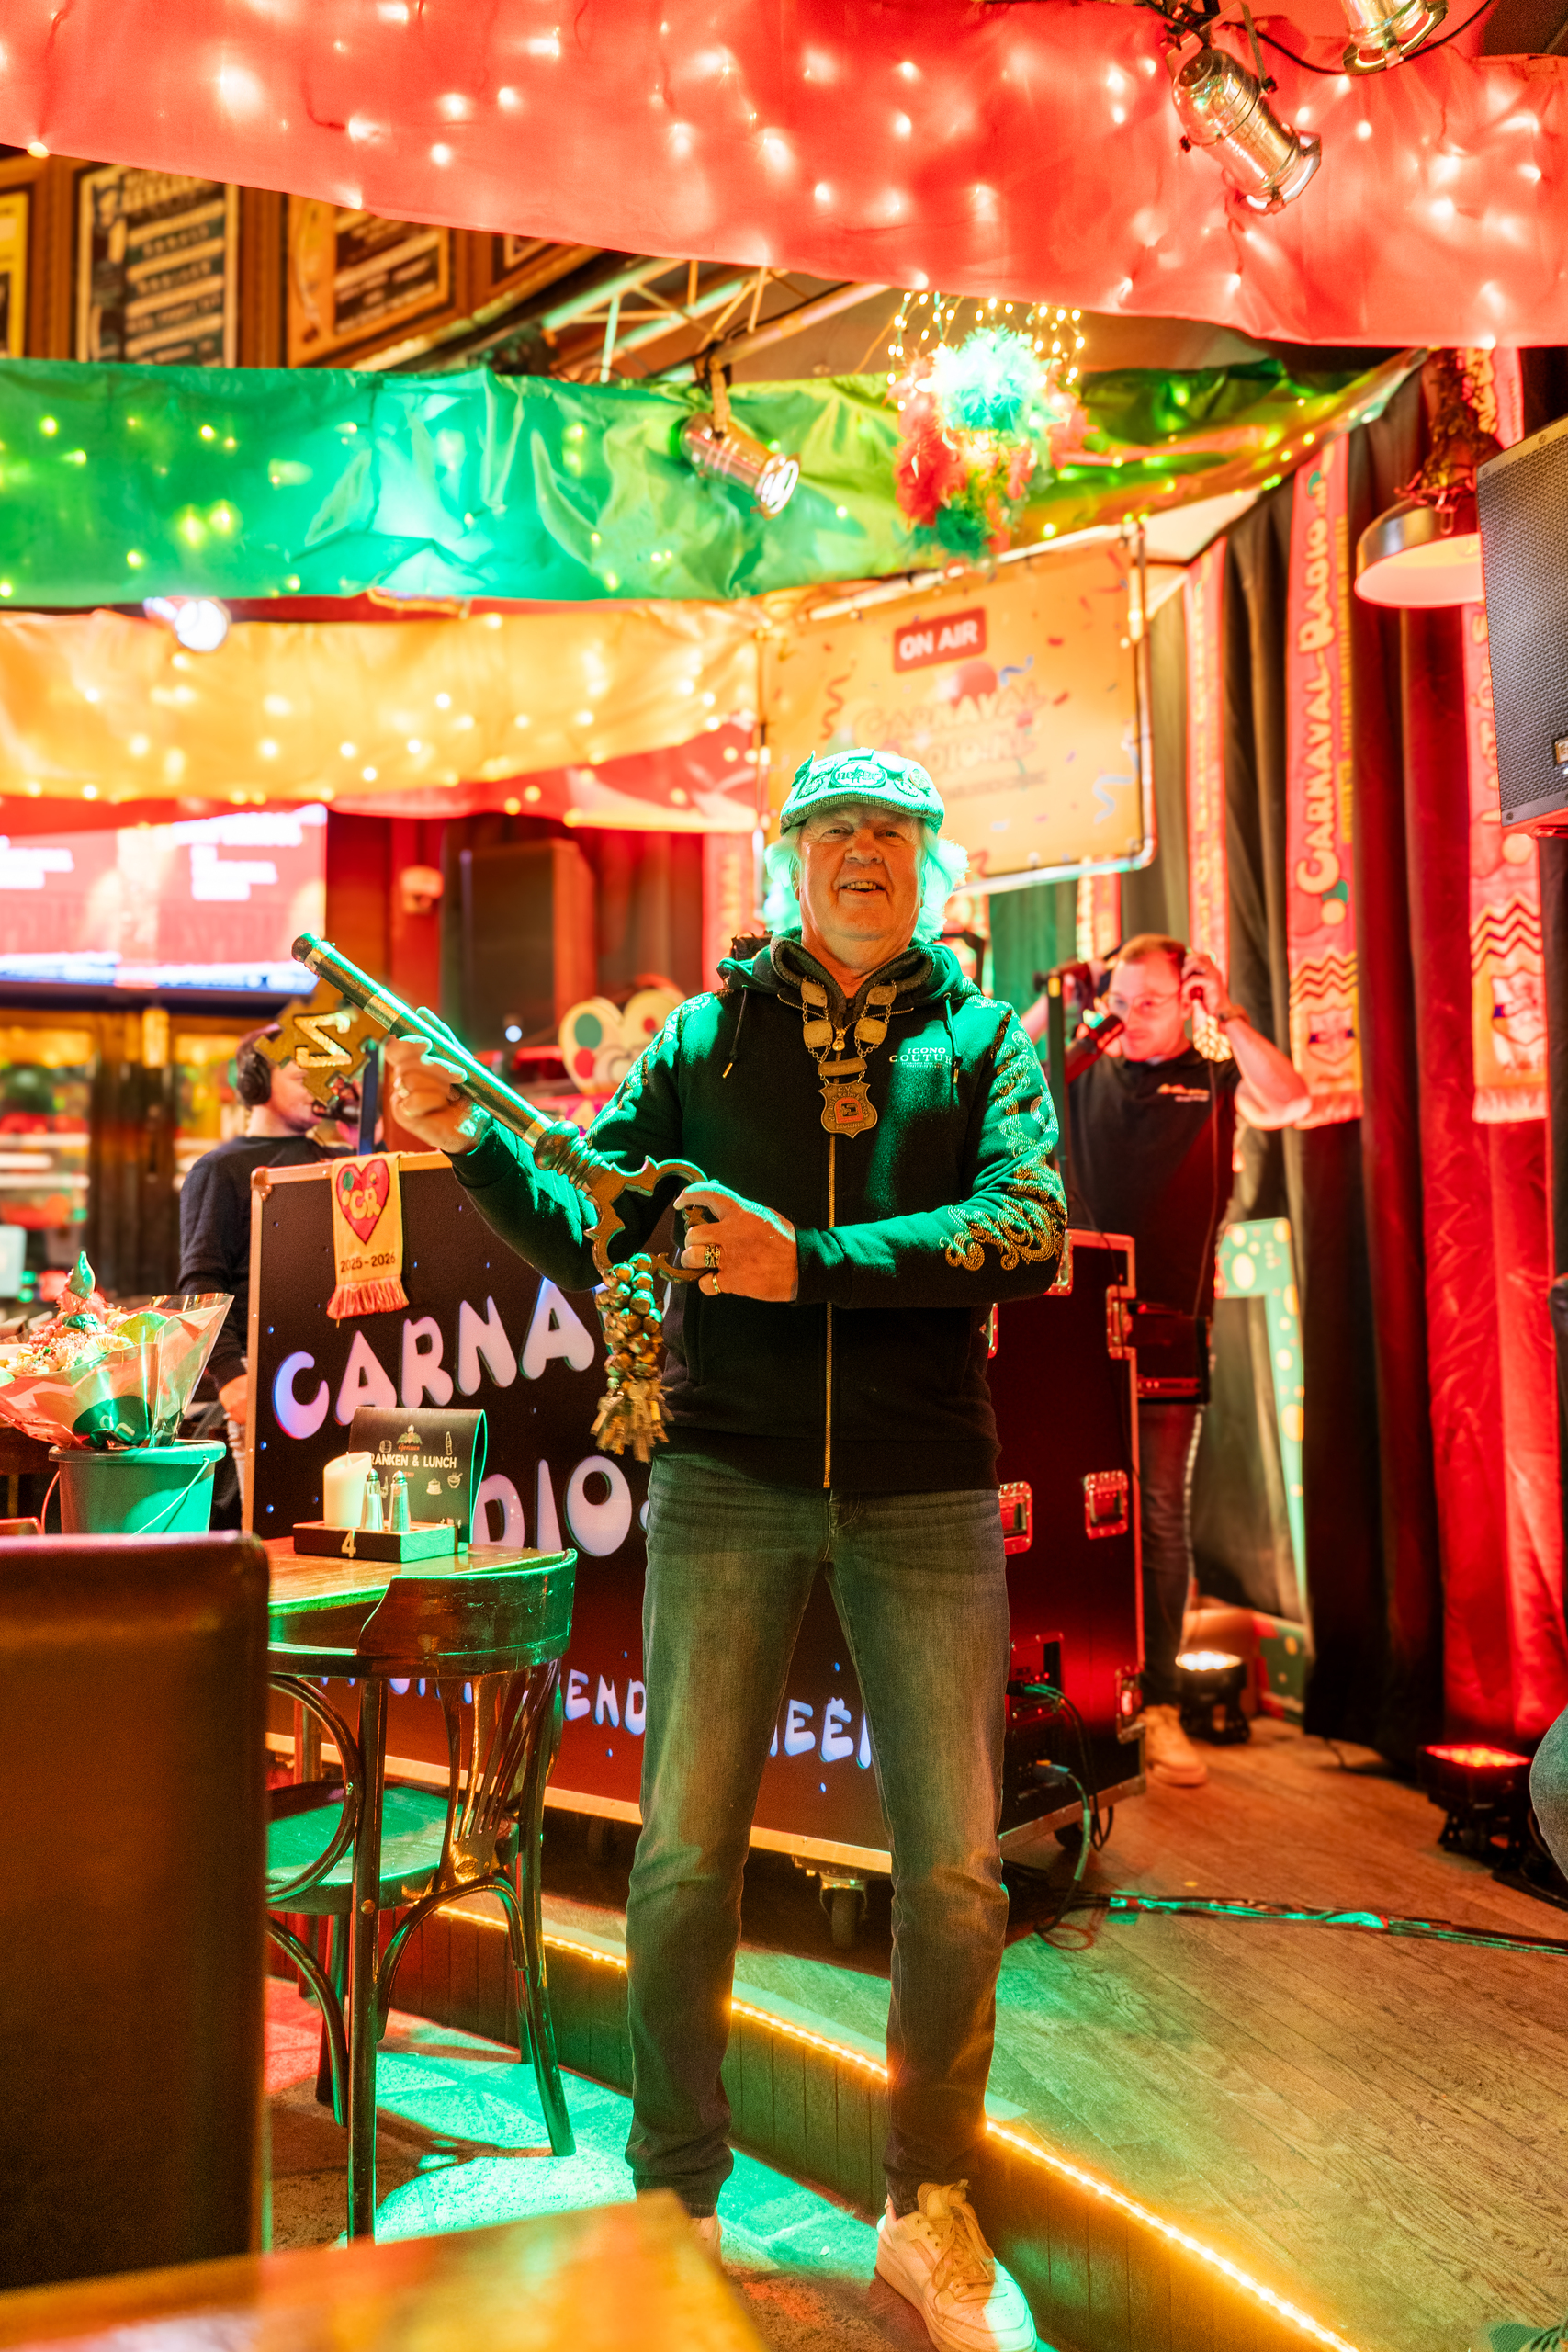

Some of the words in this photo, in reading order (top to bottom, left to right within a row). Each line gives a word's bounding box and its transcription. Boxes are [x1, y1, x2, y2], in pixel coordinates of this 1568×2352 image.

[899, 630, 934, 661] ON
[938, 619, 978, 651] AIR
[889, 1054, 953, 1066] COUTUR
[274, 1276, 608, 1440] CARNA
[371, 1453, 409, 1467] RANKEN
[412, 1454, 420, 1467] &
[423, 1455, 457, 1469] LUNCH
[471, 1455, 649, 1557] DIO
[341, 1530, 357, 1558] 4
[564, 1668, 646, 1736] END
